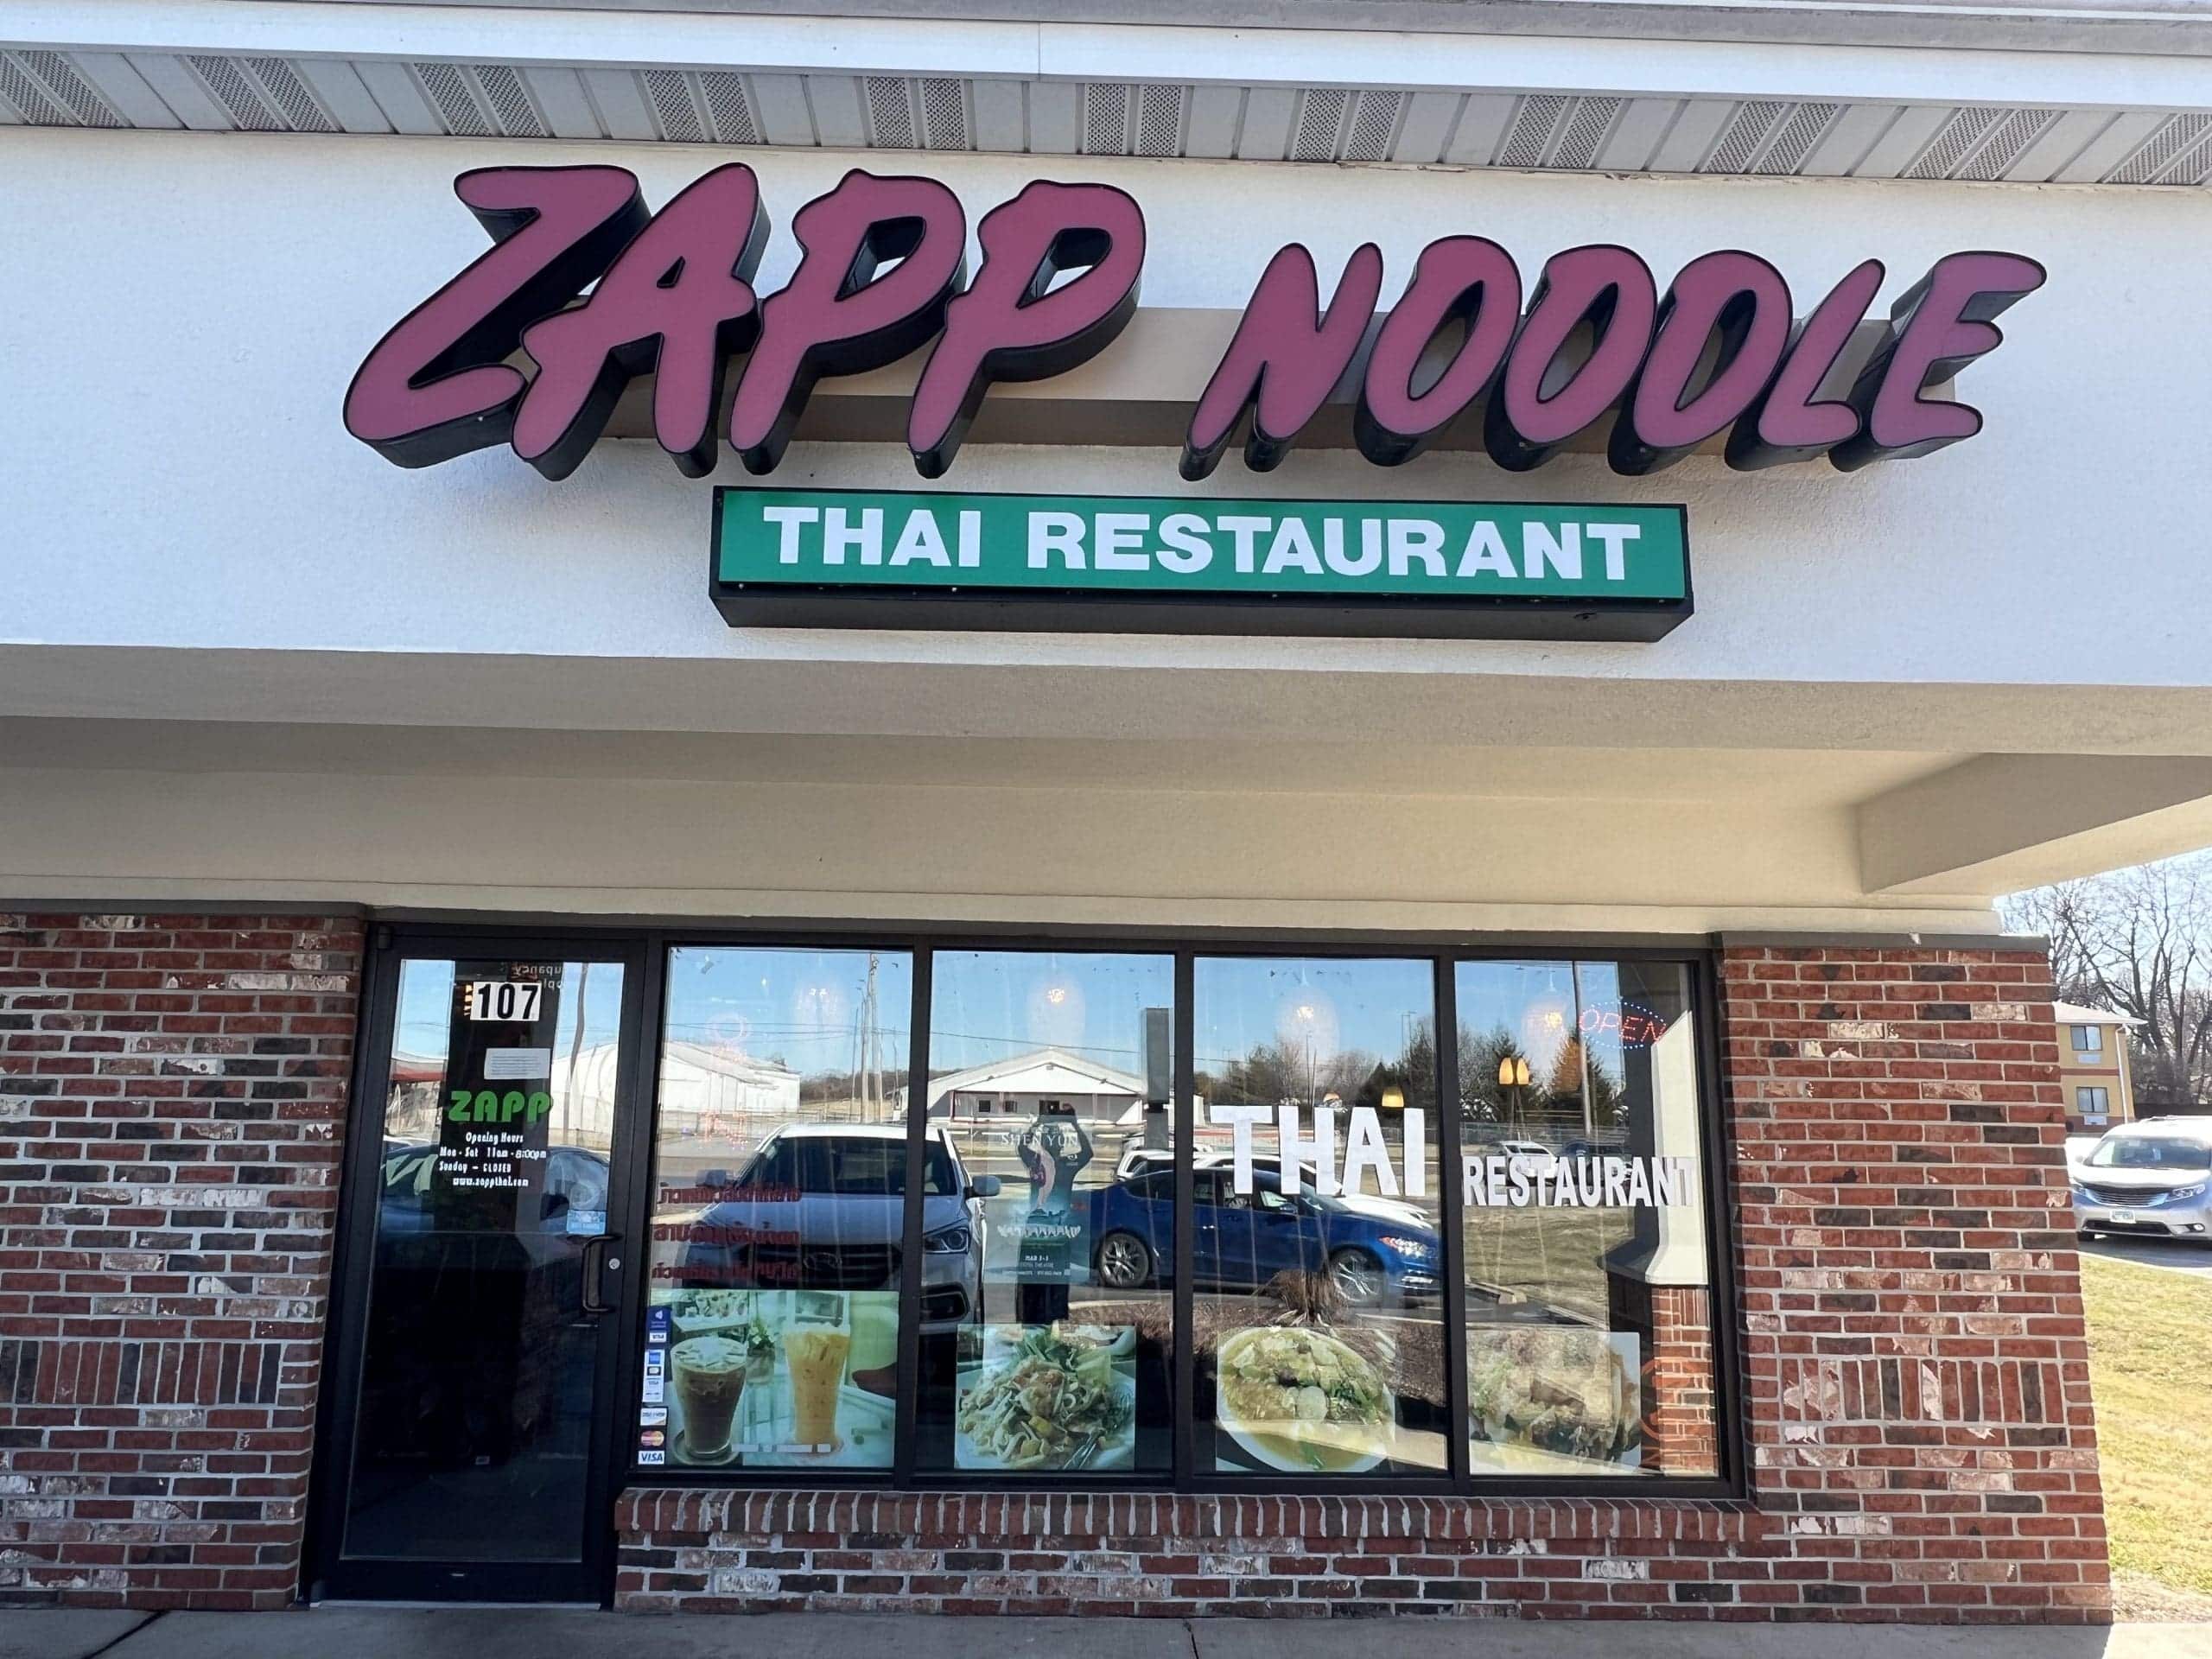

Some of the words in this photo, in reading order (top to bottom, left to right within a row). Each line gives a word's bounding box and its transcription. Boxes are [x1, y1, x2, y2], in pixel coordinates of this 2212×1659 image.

[343, 162, 1147, 475] ZAPP
[1187, 234, 2048, 477] NOODLE
[763, 506, 982, 567] THAI
[1027, 512, 1641, 581] RESTAURANT
[478, 983, 539, 1020] 107
[1579, 1008, 1668, 1043] OPEN
[448, 1090, 553, 1122] ZAPP
[465, 1147, 479, 1157] Sat
[466, 1131, 499, 1146] Opening
[1002, 1133, 1042, 1147] SHEN
[1046, 1133, 1079, 1147] YUN
[1210, 1106, 1426, 1198] THAI
[439, 1161, 467, 1173] Sunday
[1462, 1155, 1696, 1208] RESTAURANT
[641, 1452, 664, 1462] VISA
